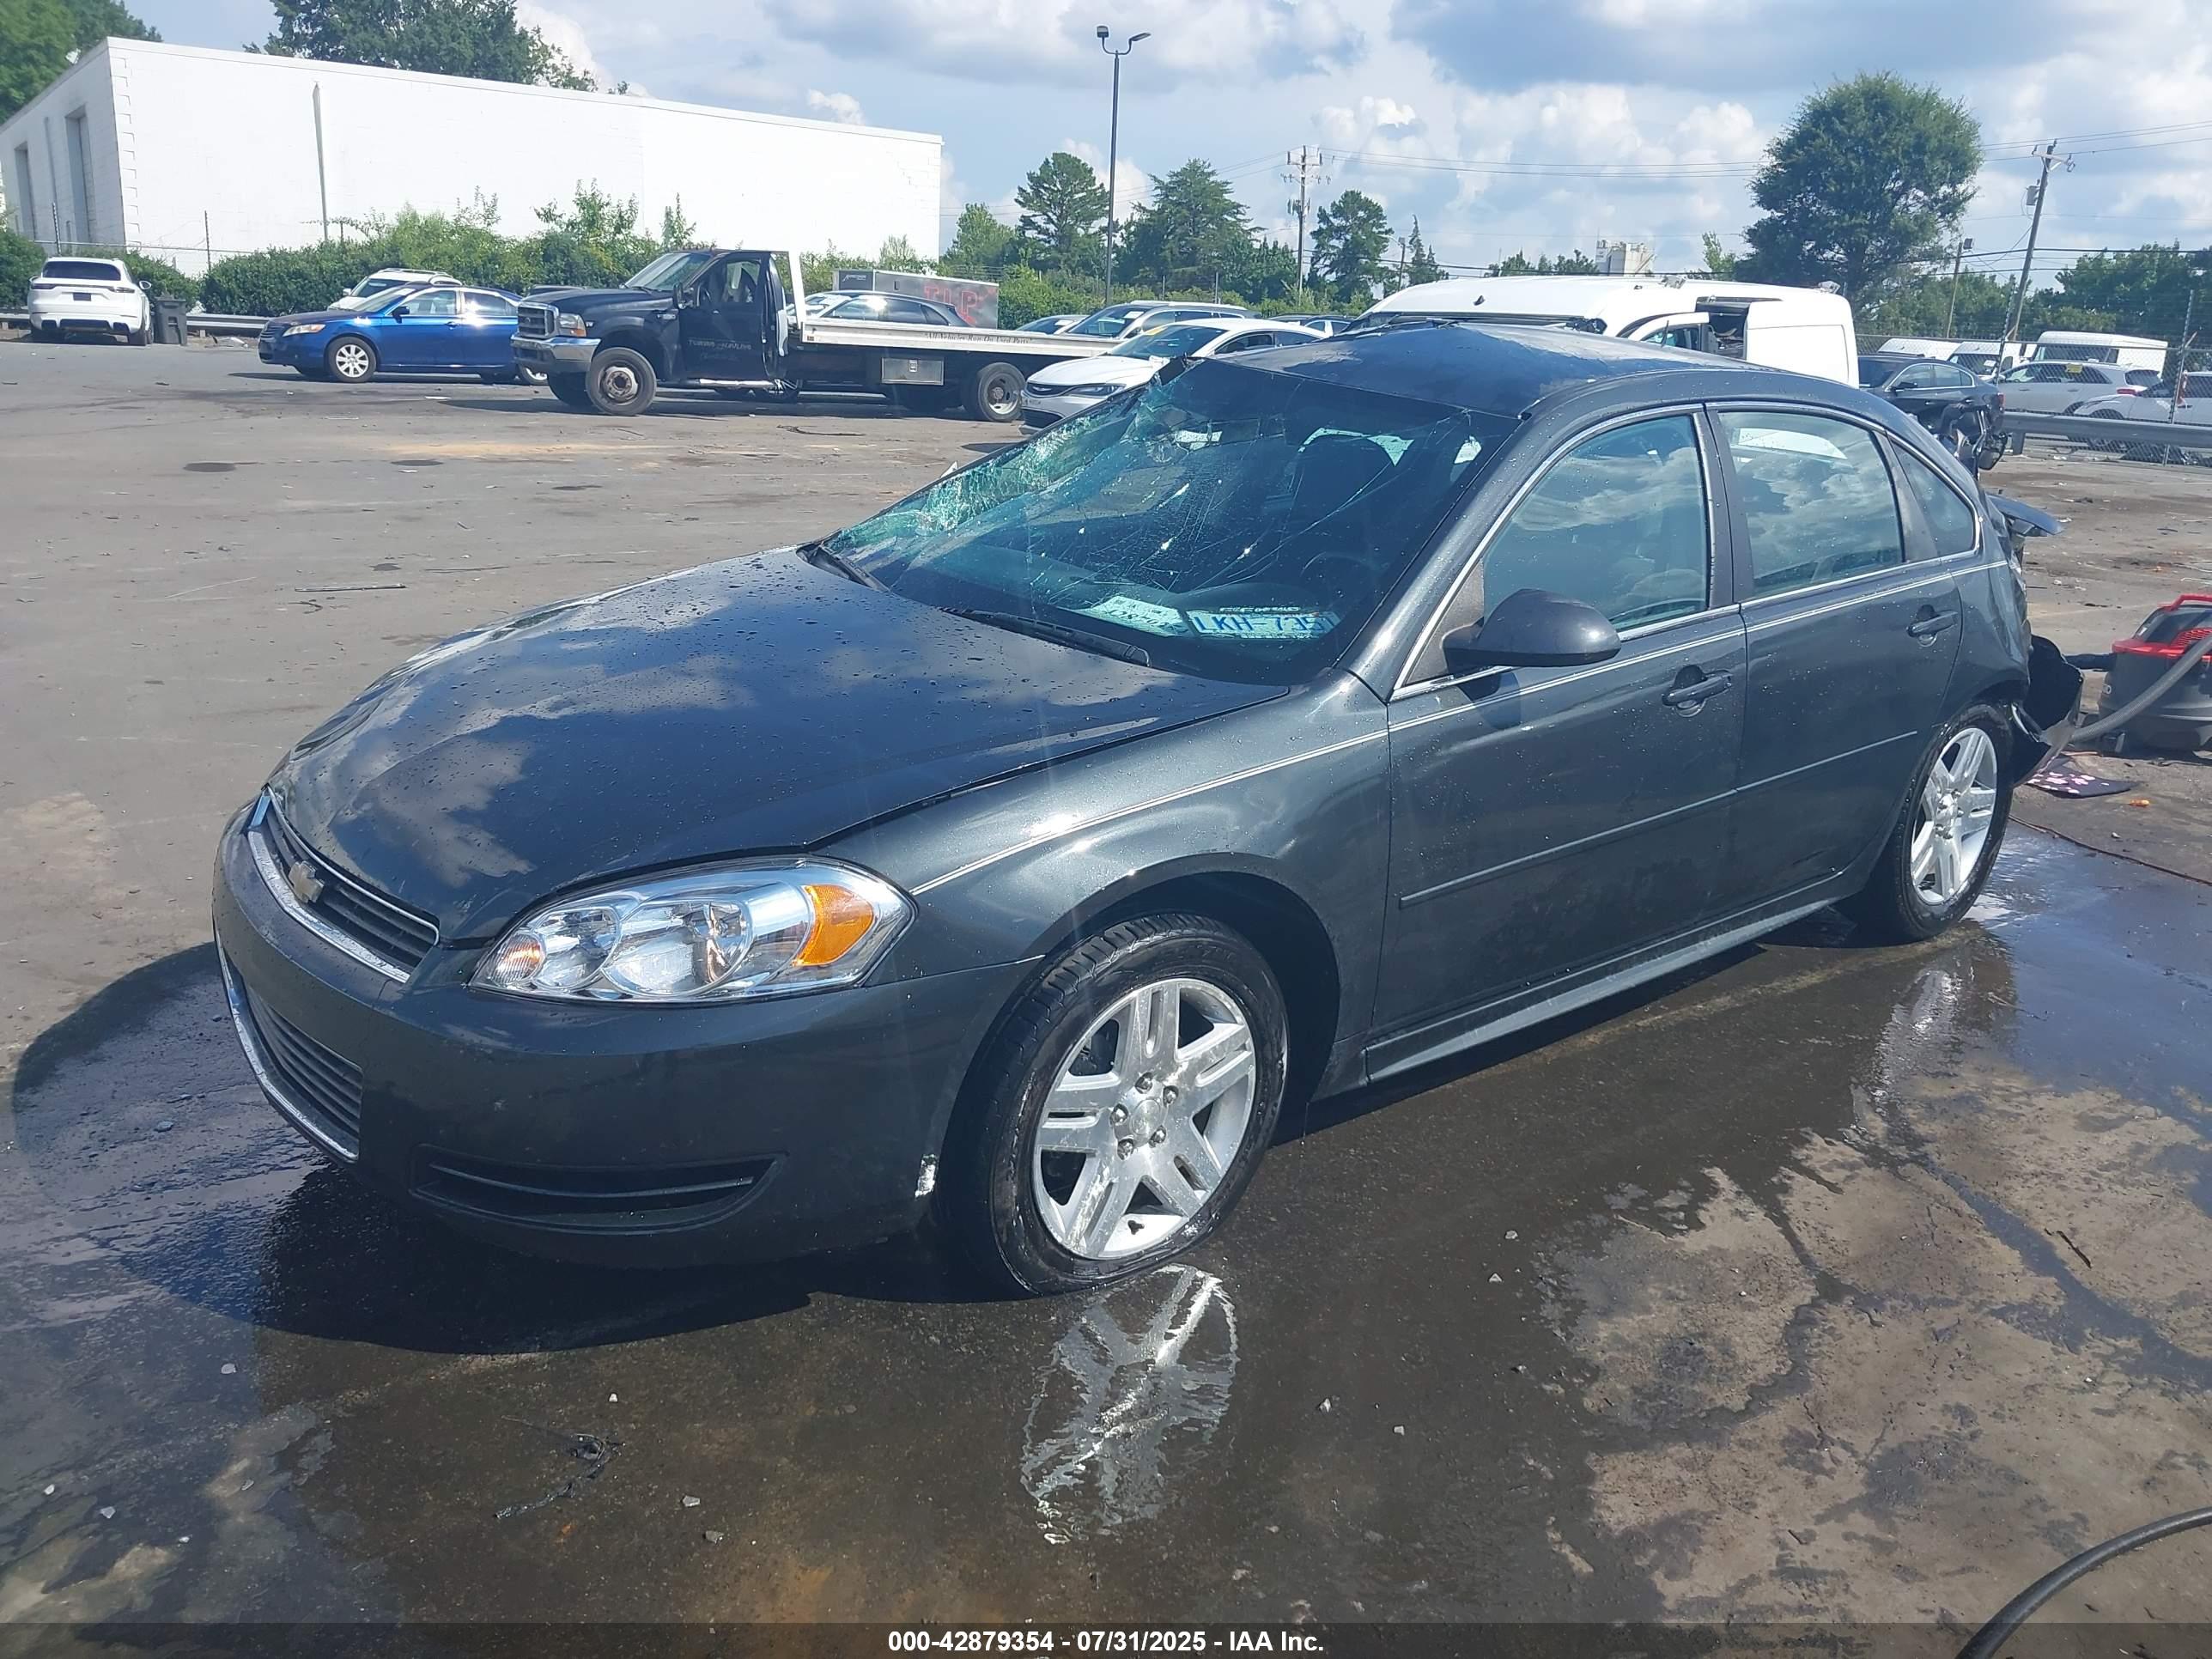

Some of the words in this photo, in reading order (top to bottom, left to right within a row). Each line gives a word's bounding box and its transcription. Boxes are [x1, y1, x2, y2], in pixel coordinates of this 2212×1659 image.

[939, 332, 966, 341] Vehicles
[968, 333, 981, 342] Run
[995, 335, 1011, 343] Used
